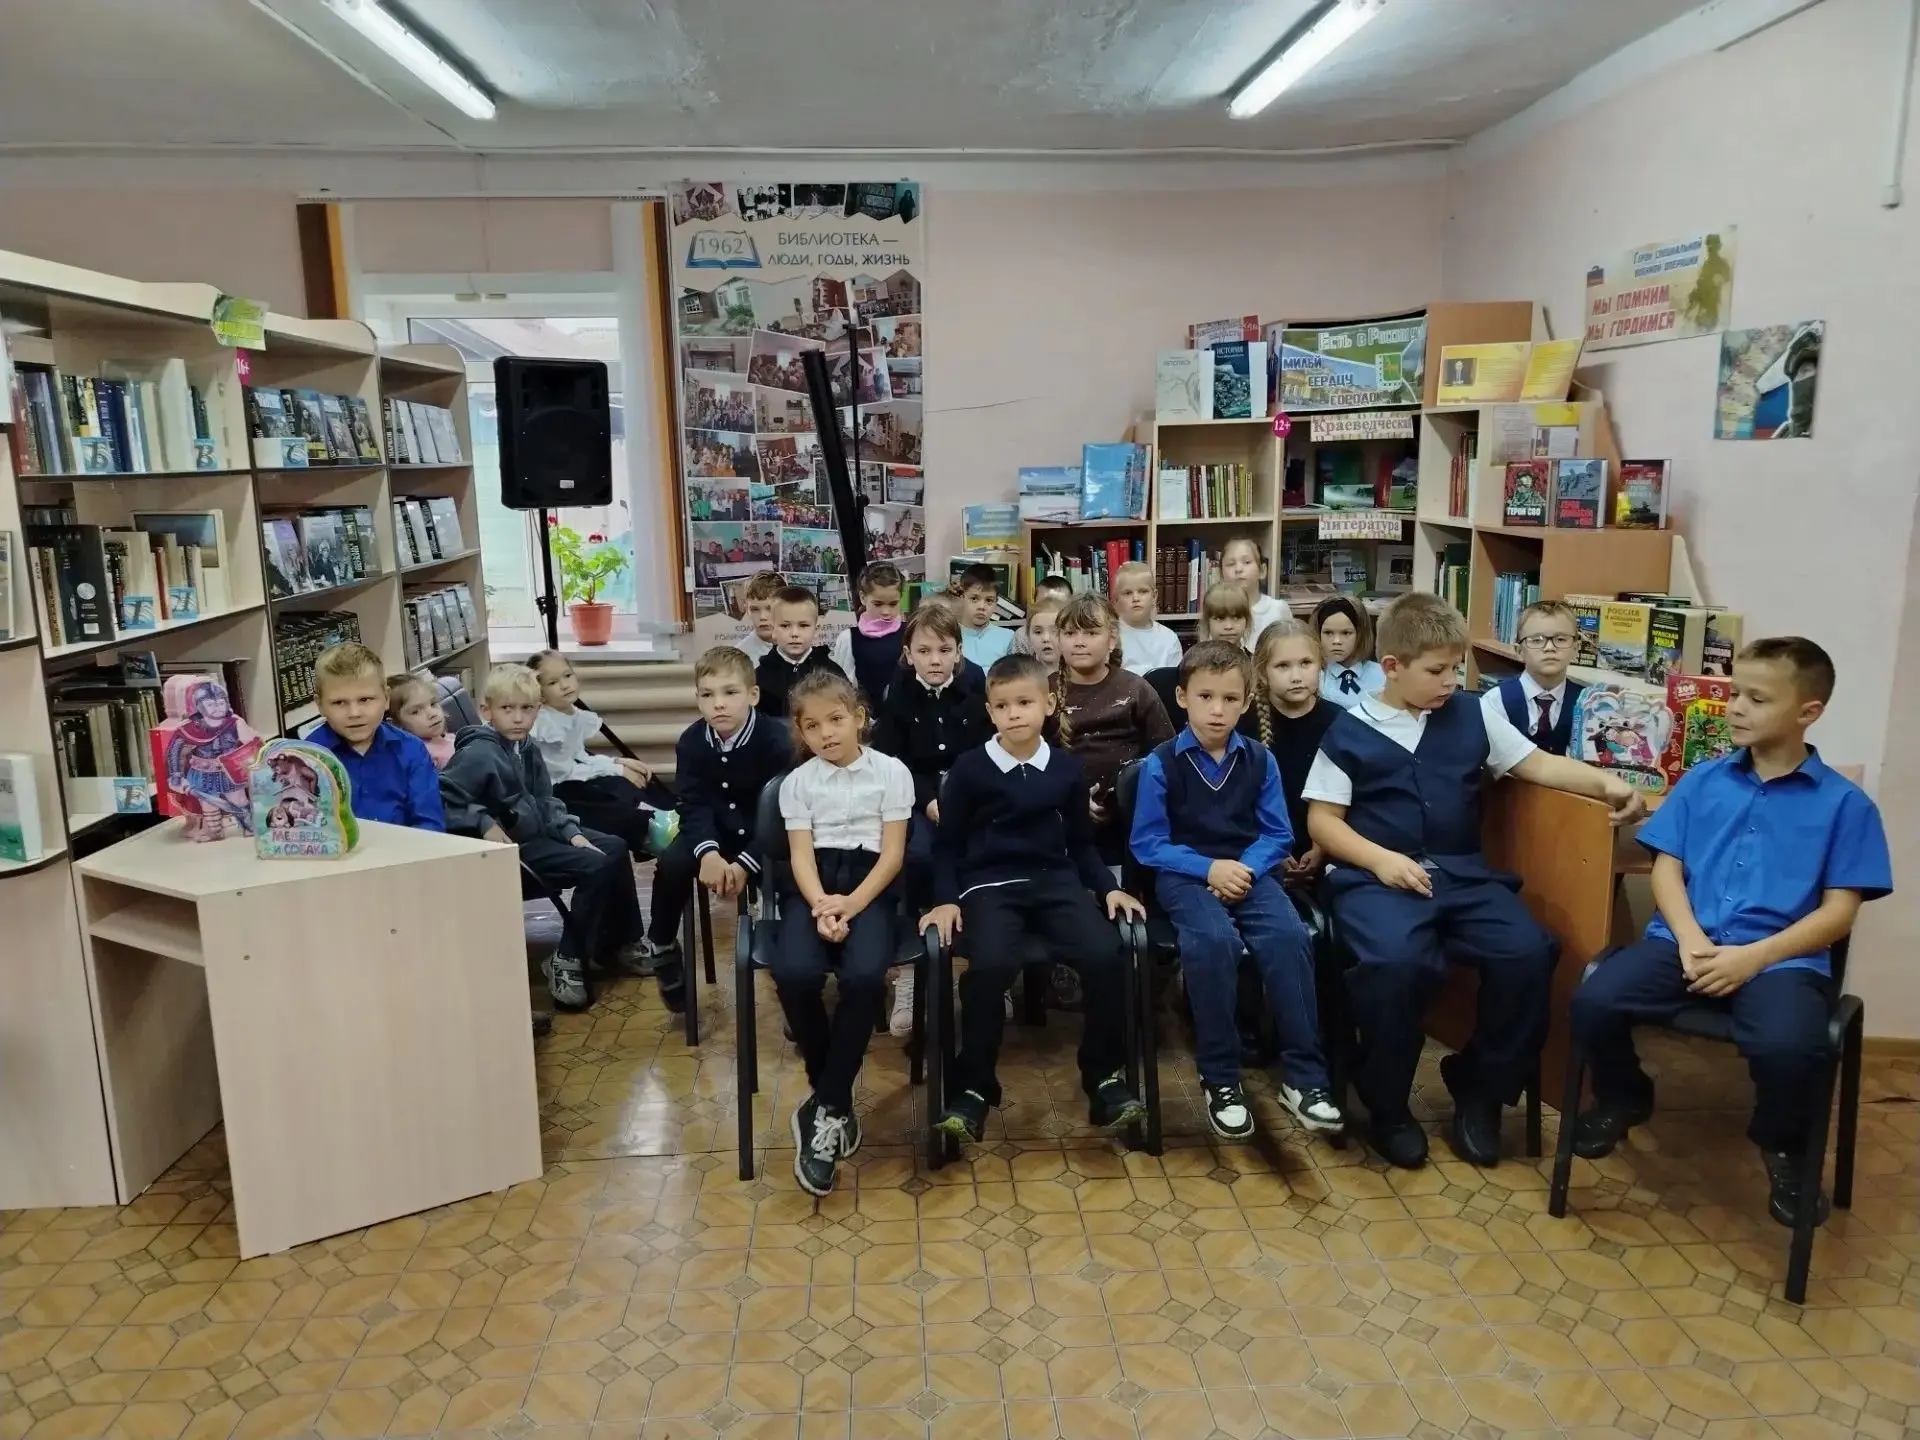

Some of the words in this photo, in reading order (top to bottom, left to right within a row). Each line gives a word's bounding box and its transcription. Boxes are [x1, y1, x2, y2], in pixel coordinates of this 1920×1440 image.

[699, 237, 744, 255] 1962
[778, 232, 880, 246] БИБЛИОТЕКА
[768, 254, 813, 267] ЛЮДИ,
[817, 254, 858, 267] ГОДЫ,
[862, 253, 911, 266] ЖИЗНЬ
[1592, 298, 1612, 316] МЫ
[1615, 285, 1670, 312] ПОМНИМ
[1587, 321, 1606, 342] МЫ
[1609, 311, 1676, 338] ГОРДИМСЯ
[1273, 420, 1291, 431] 12+
[272, 829, 328, 841] МЕДВЕДЬ
[284, 844, 329, 855] СОБАКА
